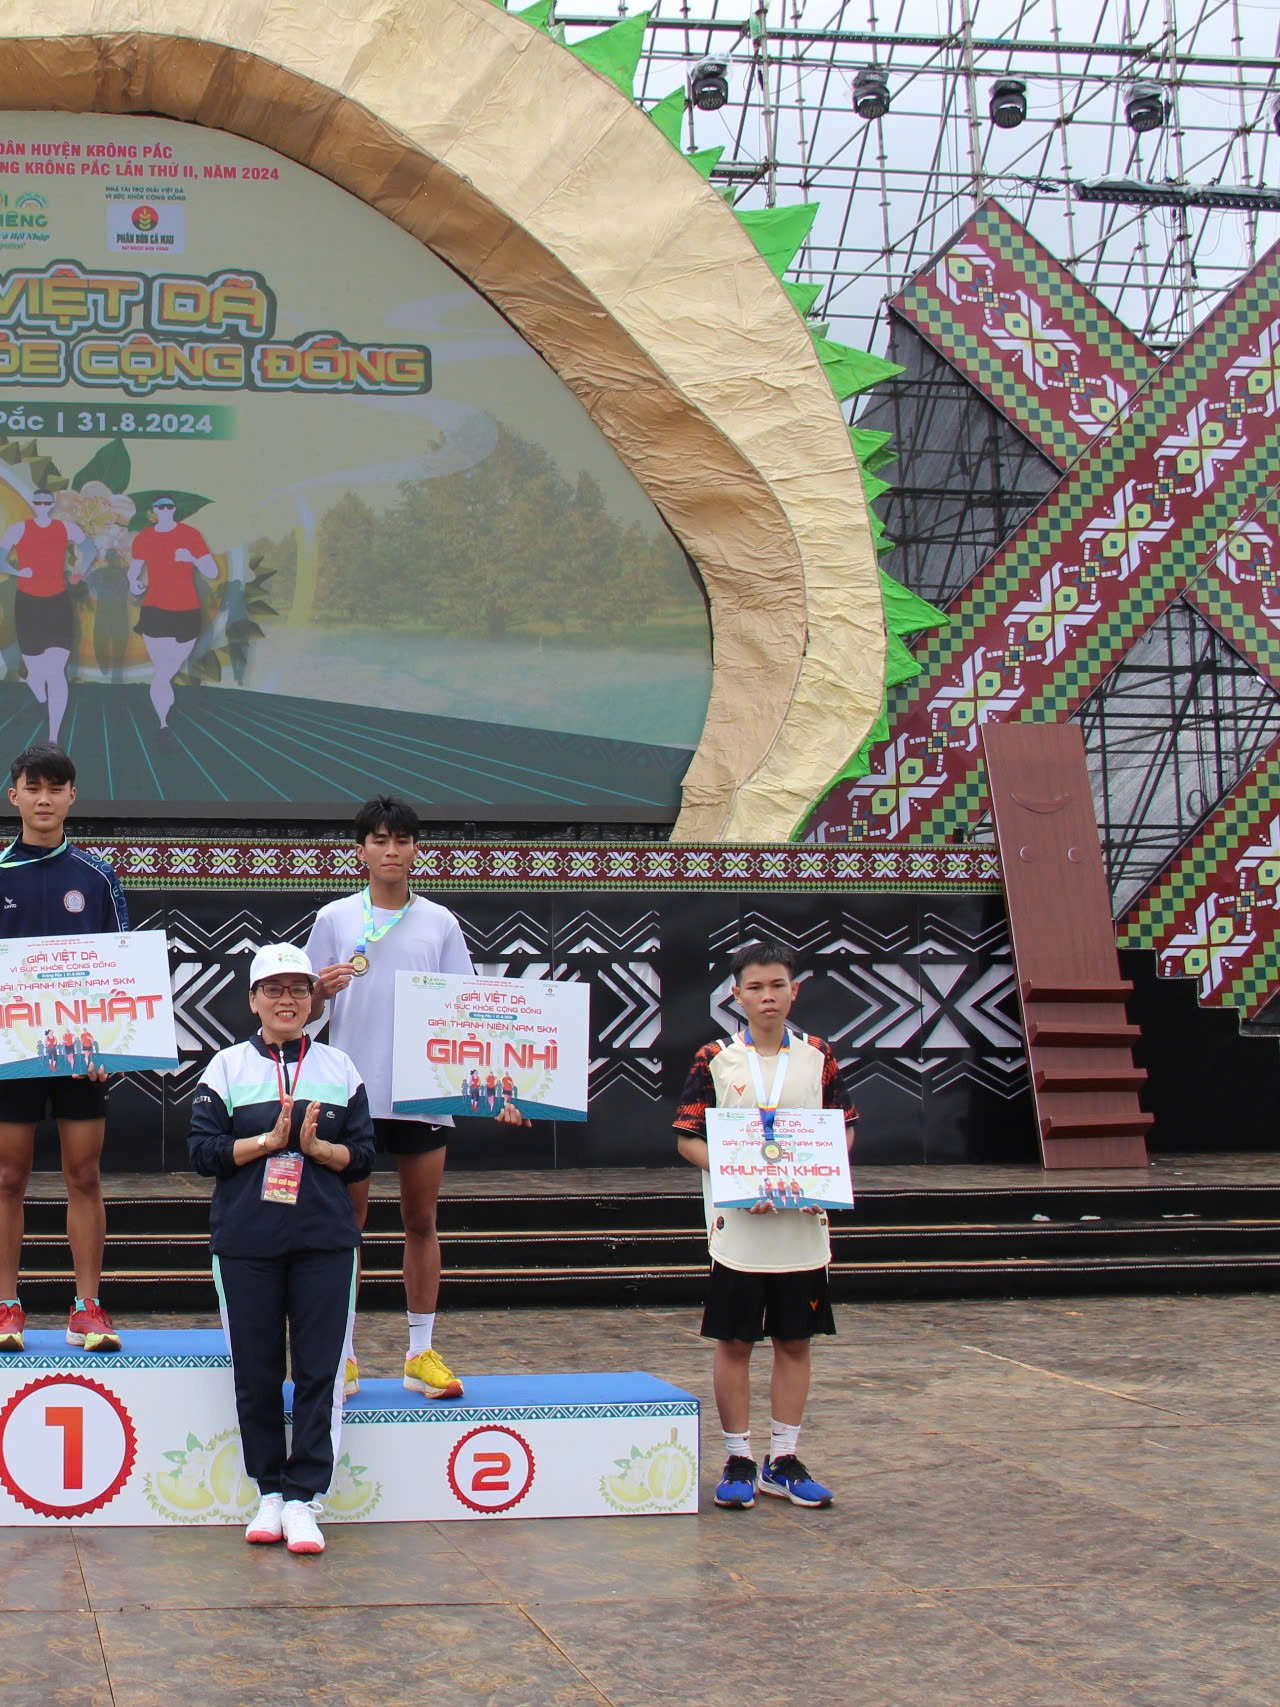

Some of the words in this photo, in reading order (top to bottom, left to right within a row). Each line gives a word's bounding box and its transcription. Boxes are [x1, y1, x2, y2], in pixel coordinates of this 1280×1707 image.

[31, 141, 81, 160] HUYỆN
[87, 142, 137, 158] KRÔNG
[25, 160, 75, 176] KRÔNG
[149, 163, 179, 178] THỨ
[183, 166, 199, 180] II,
[203, 163, 237, 179] NĂM
[242, 167, 280, 180] 2024
[160, 277, 262, 328] DÃ
[80, 335, 243, 384] CỘNG
[77, 411, 213, 433] 31.8.2024
[26, 951, 48, 964] GIẢI
[52, 949, 76, 965] VIỆT
[66, 962, 91, 971] CỘNG
[17, 982, 55, 991] THANH
[57, 979, 81, 989] NIÊN
[85, 978, 110, 988] NAM
[113, 977, 135, 986] 5KM
[54, 988, 163, 1026] NHẤT
[461, 990, 481, 1002] GIẢI
[484, 991, 508, 1005] VIỆT
[428, 1018, 447, 1027] GIẢI
[450, 1020, 485, 1029] THANH
[486, 1020, 509, 1031] NIÊN
[511, 1024, 535, 1033] NAM
[537, 1025, 558, 1034] 5KM
[426, 1033, 492, 1067] GIẢI
[504, 1039, 559, 1071] NHÌ
[794, 1163, 841, 1177] KHÍCH
[45, 1406, 83, 1490] 1
[472, 1452, 511, 1491] 2
